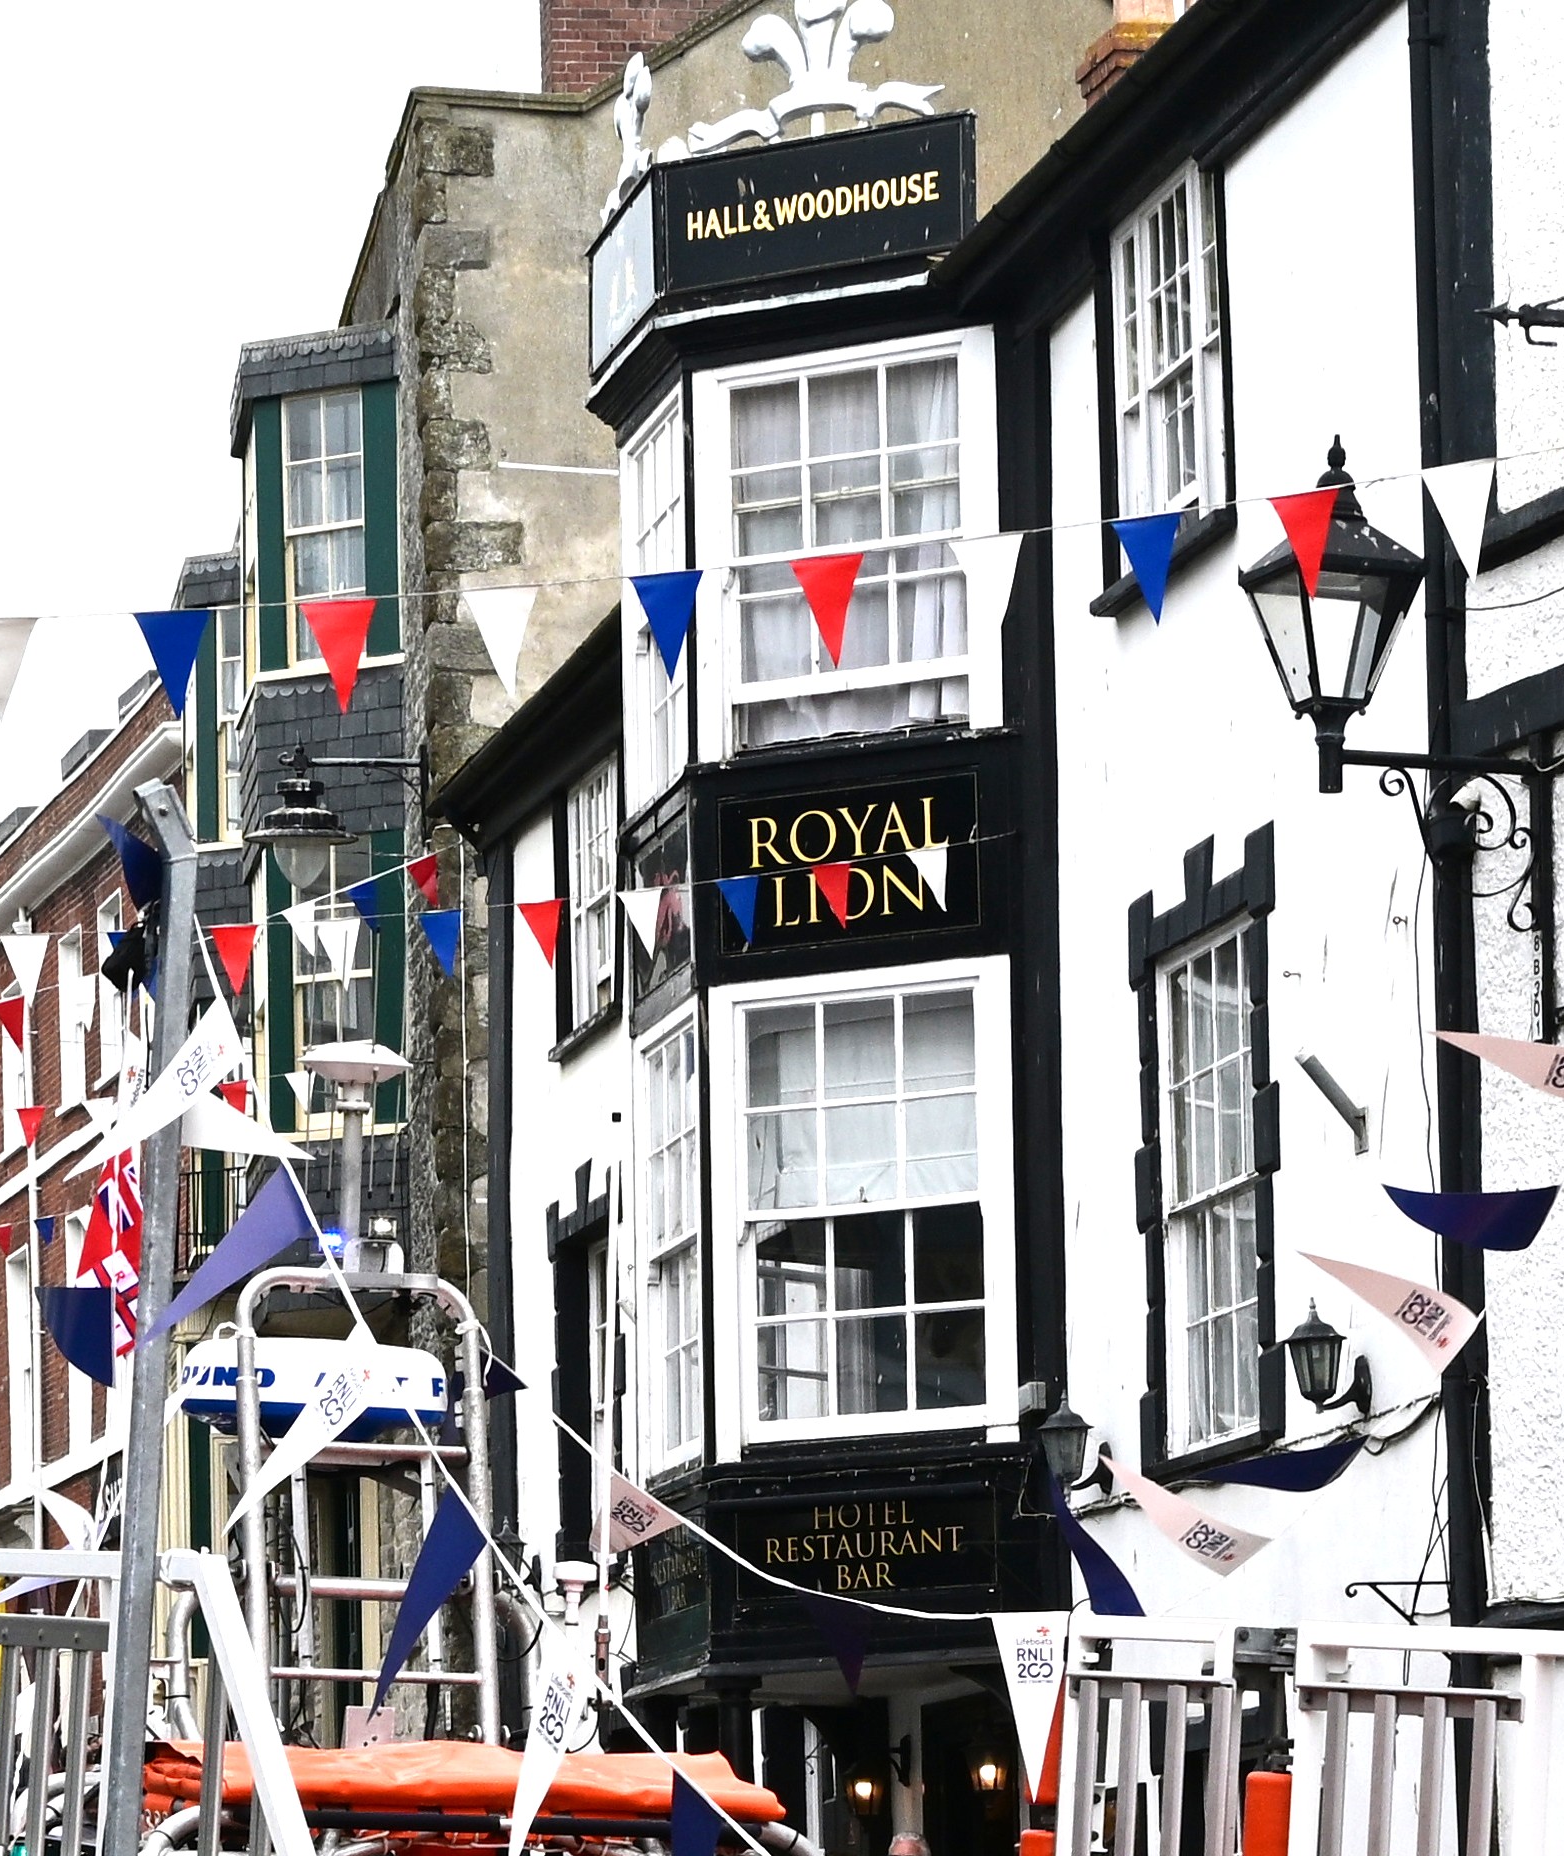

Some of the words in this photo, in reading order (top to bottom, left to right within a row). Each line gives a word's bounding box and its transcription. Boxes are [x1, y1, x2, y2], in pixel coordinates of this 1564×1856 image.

[748, 797, 950, 868] ROYAL
[617, 1500, 653, 1527] RNLI
[813, 1501, 915, 1529] HOTEL
[765, 1525, 967, 1563] RESTAURANT
[836, 1562, 897, 1590] BAR
[1017, 1647, 1053, 1661] RNLI
[545, 1686, 571, 1724] RNLI
